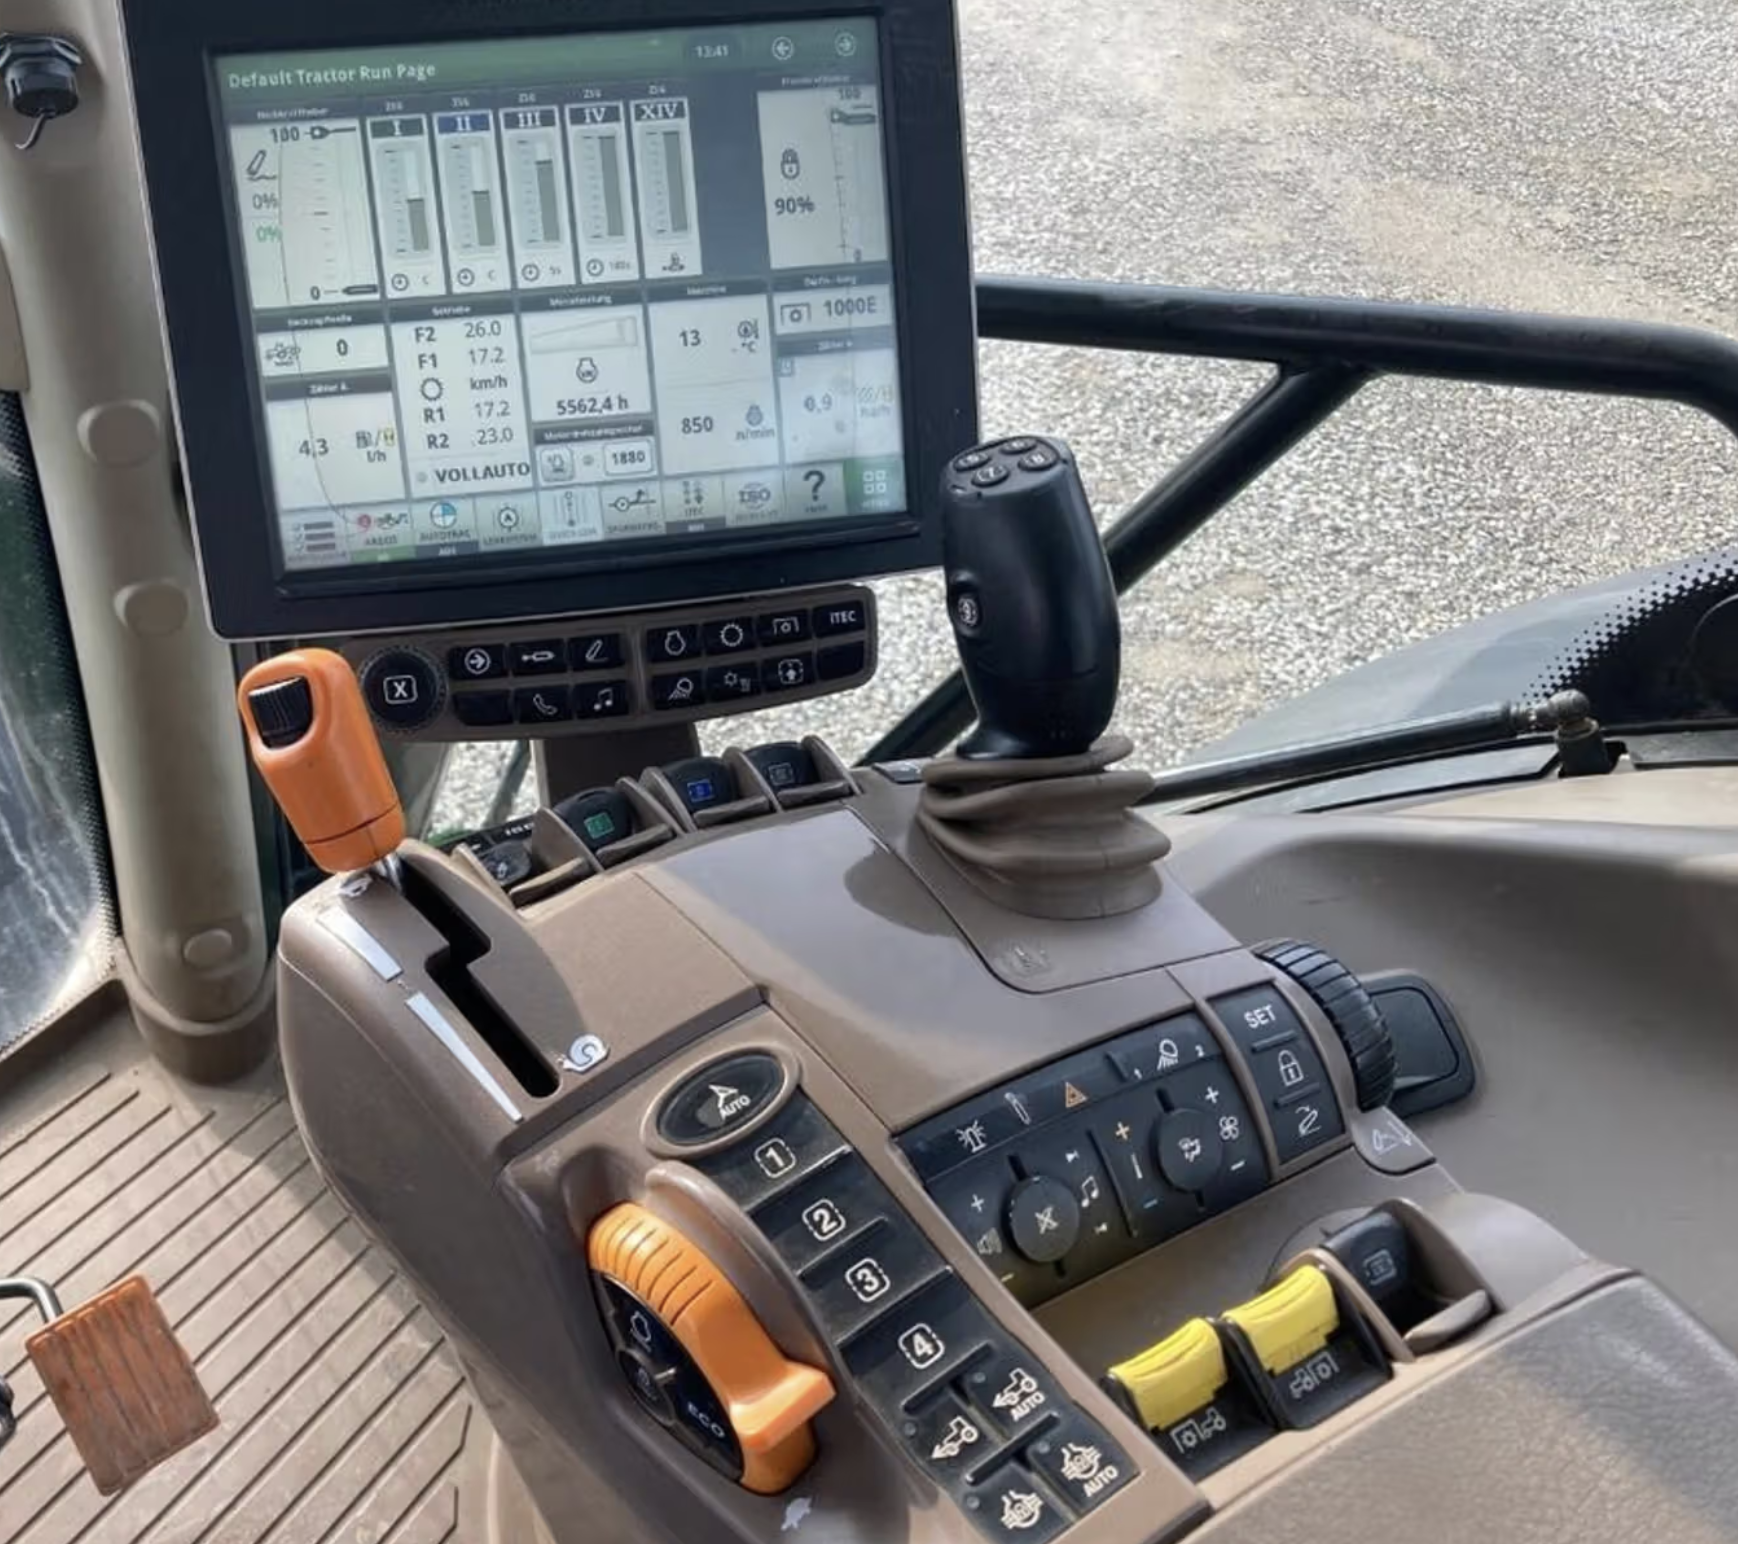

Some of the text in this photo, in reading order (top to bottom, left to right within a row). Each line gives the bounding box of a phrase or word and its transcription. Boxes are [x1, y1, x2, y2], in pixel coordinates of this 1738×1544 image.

[229, 63, 436, 88] Default Tractor Run Page
[518, 112, 541, 127] III
[583, 108, 606, 123] IV
[641, 103, 679, 120] XIV
[393, 121, 401, 136] I
[456, 115, 472, 131] II
[271, 127, 300, 143] 100
[252, 193, 278, 209] 0%
[774, 197, 815, 214] 90%
[257, 226, 282, 243] 0%
[311, 286, 321, 300] 0
[823, 296, 877, 317] 1000E
[414, 320, 501, 343] F2 26.0
[680, 331, 701, 347] 13
[336, 339, 348, 356] 0
[418, 347, 505, 369] F1 17.2
[470, 375, 508, 391] km/h
[424, 401, 510, 423] R1 17.2
[556, 396, 628, 416] 5562,4 h
[681, 417, 714, 434] 850
[299, 438, 329, 458] 4,3
[427, 427, 513, 450] R2 23.0
[612, 450, 645, 465] 1880
[435, 462, 531, 483] VOLLAUTO
[829, 611, 857, 624] ITEC
[1244, 1004, 1276, 1028] SET
[719, 1094, 751, 1119] AUTO
[766, 1149, 785, 1167] 1
[813, 1208, 834, 1232] 2
[857, 1268, 879, 1293] 3
[912, 1333, 932, 1357] 4
[1011, 1391, 1045, 1422] AUTO
[687, 1401, 725, 1437] ECO
[1083, 1466, 1119, 1498] AUTO
